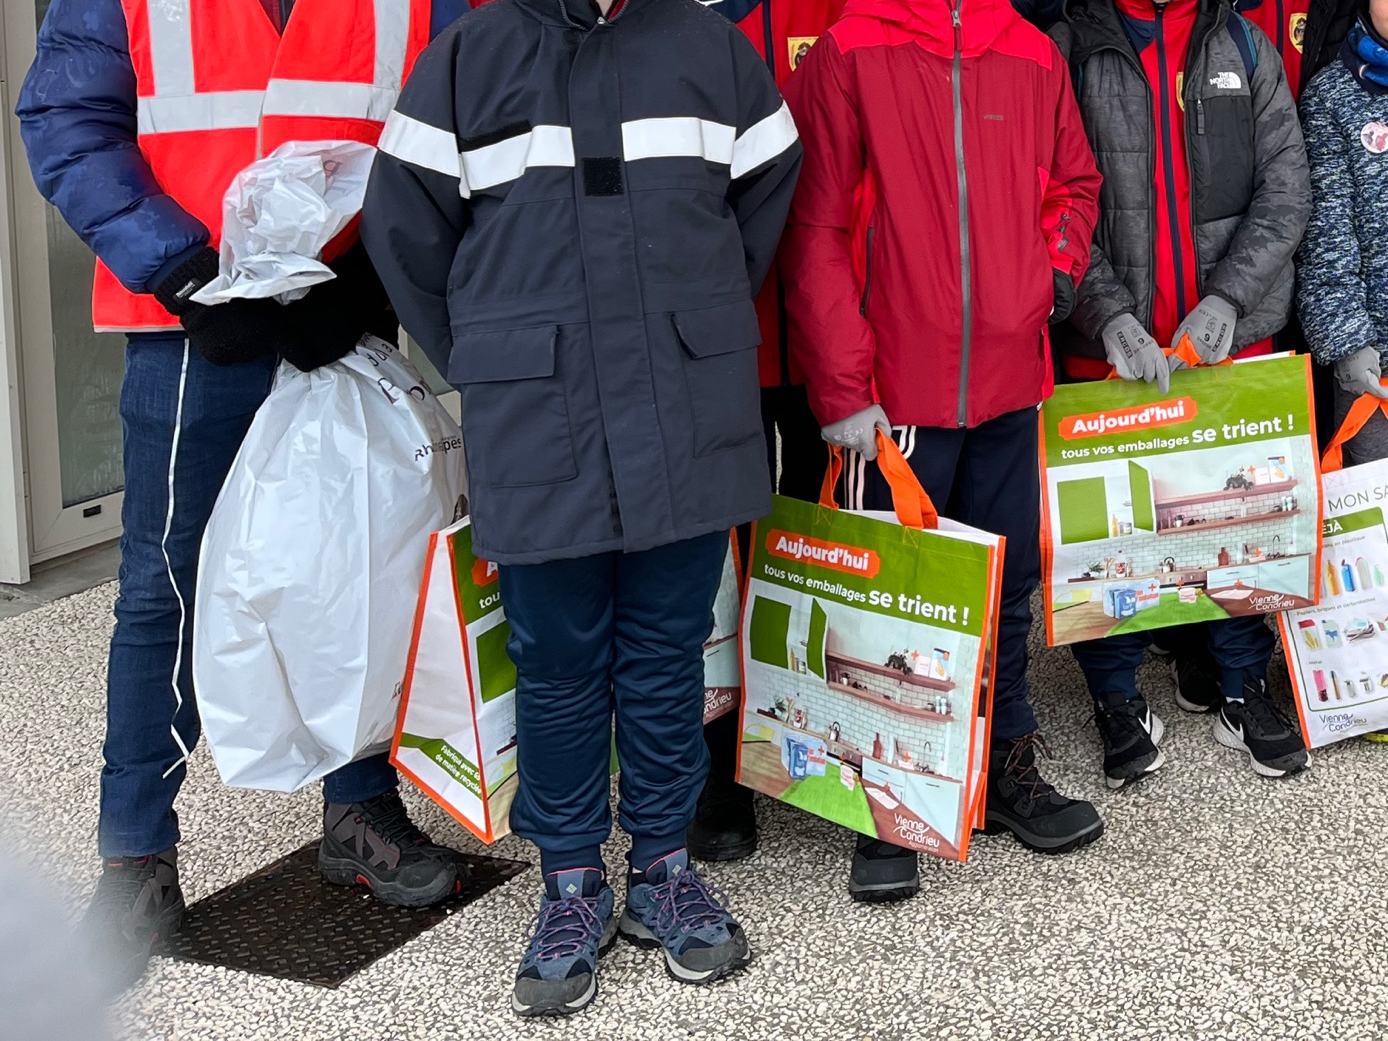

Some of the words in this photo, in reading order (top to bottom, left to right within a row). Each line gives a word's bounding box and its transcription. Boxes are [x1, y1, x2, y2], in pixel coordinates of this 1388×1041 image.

[1072, 401, 1184, 434] Aujourd'hui
[1061, 448, 1089, 459] tous
[1092, 445, 1114, 455] vos
[1117, 435, 1190, 452] emballages
[1192, 429, 1216, 443] se
[1222, 417, 1282, 439] trient
[1328, 489, 1370, 512] MON
[775, 536, 870, 571] Aujourd'hui
[479, 591, 500, 609] tou
[764, 564, 786, 580] tous
[787, 573, 804, 585] vos
[806, 576, 866, 604] emballages
[868, 589, 893, 608] se
[898, 593, 957, 625] trient
[894, 812, 925, 831] Vienne
[900, 828, 940, 848] Condrieu
